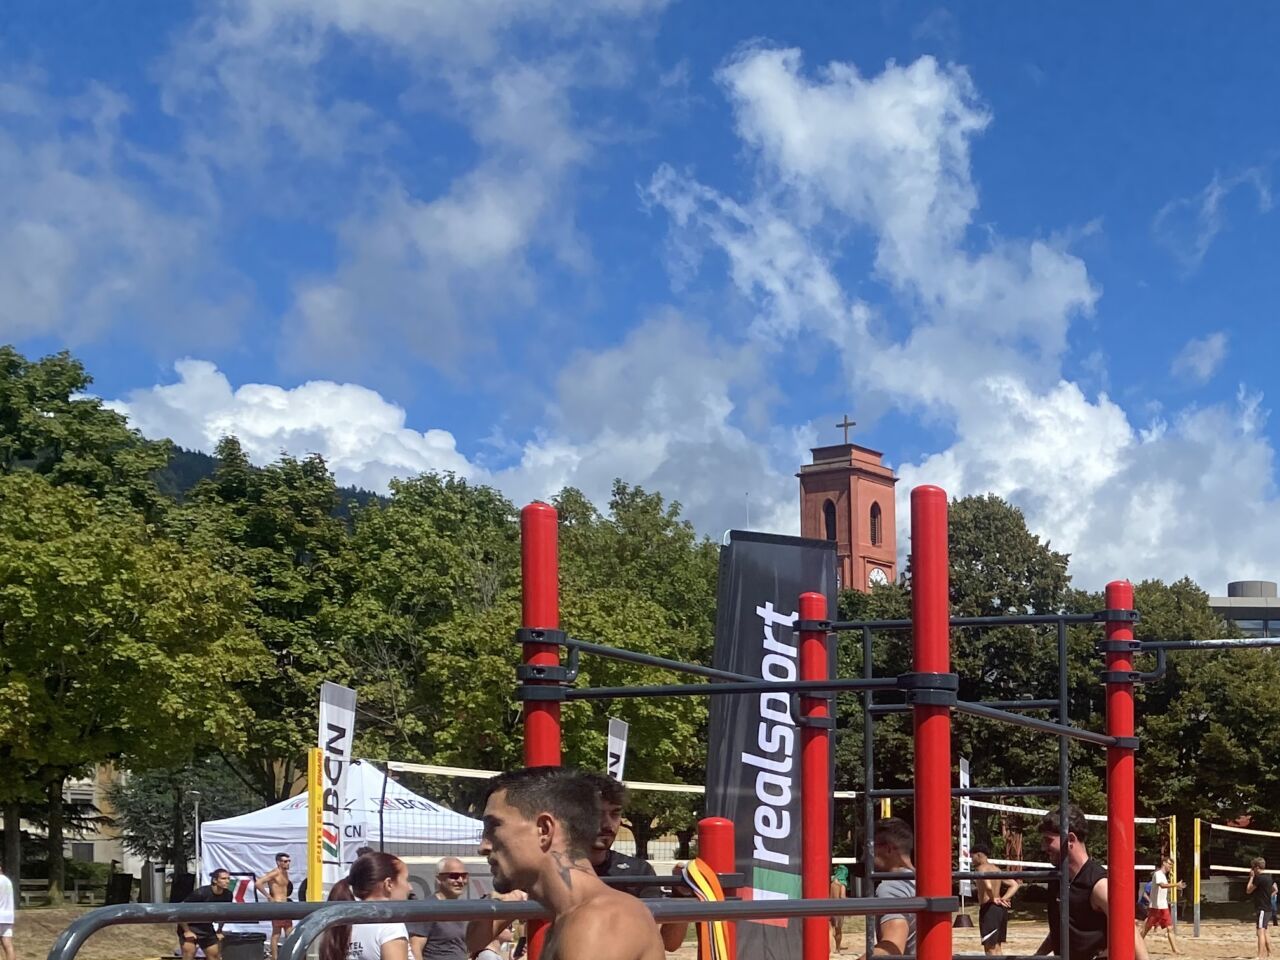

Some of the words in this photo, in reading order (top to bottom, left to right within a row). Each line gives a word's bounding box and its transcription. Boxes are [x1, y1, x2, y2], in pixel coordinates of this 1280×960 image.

[741, 601, 799, 865] realsport
[323, 723, 347, 815] BCN
[344, 825, 362, 838] CN
[394, 798, 440, 812] BCN
